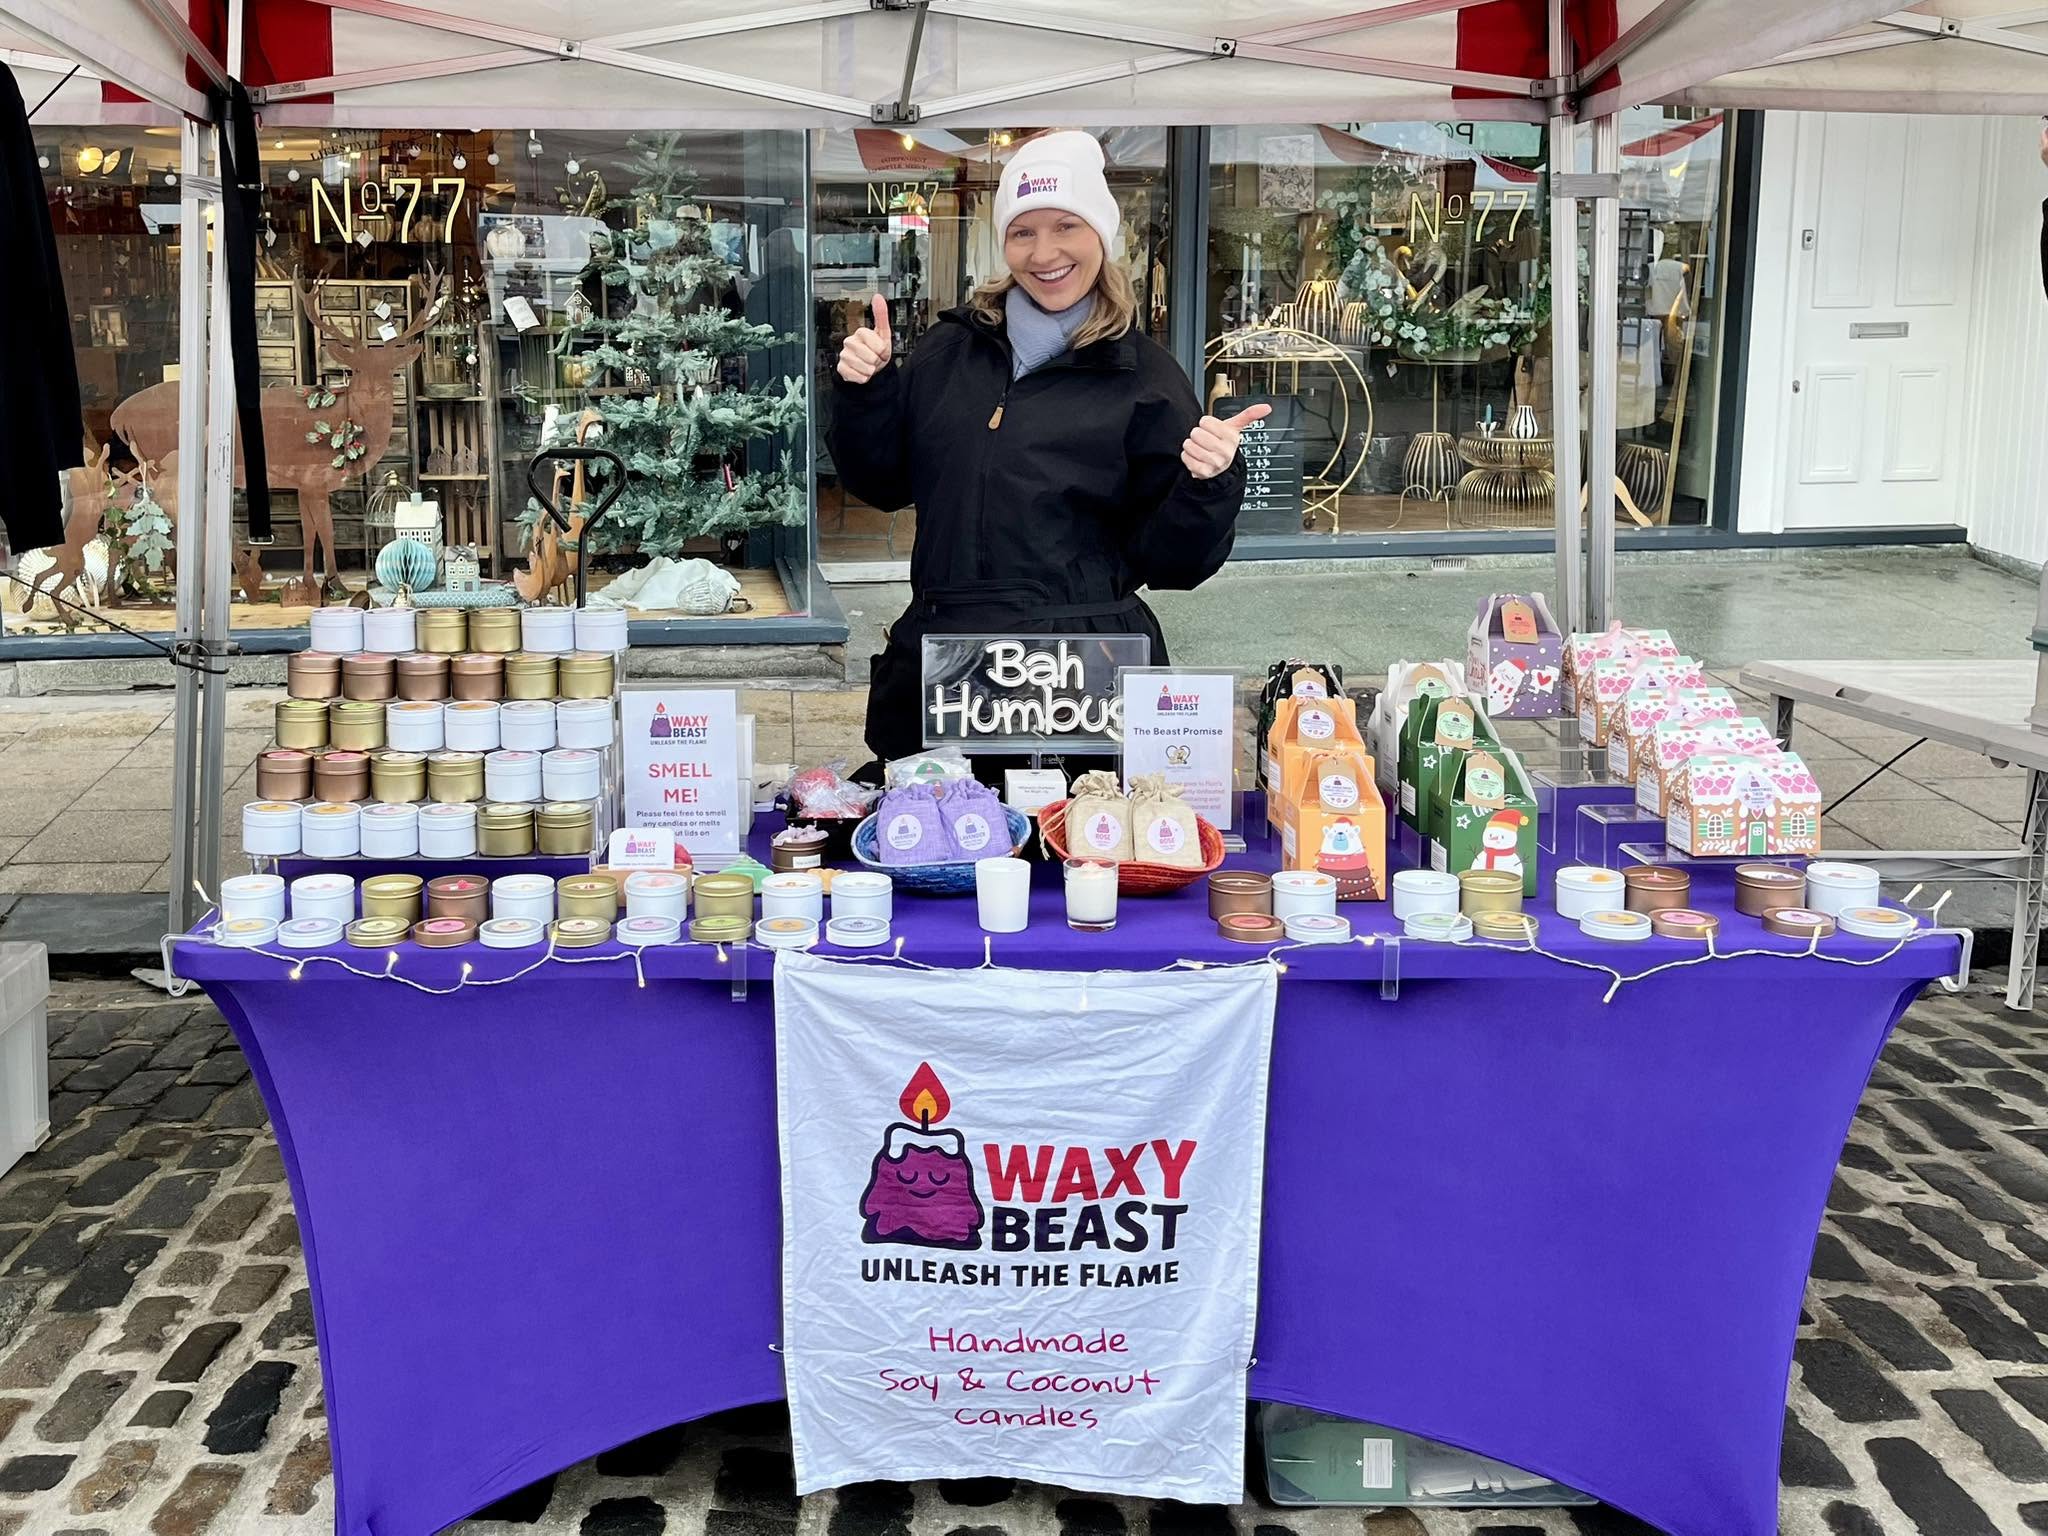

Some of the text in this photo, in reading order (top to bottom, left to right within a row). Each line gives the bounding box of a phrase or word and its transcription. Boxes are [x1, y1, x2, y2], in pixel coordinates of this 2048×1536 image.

[1031, 178, 1058, 186] WAXY
[1032, 185, 1058, 193] BEAST
[984, 639, 1085, 689] Bah
[1172, 694, 1199, 703] WAXY
[1173, 703, 1198, 711] BEAST
[671, 715, 708, 727] WAXY
[673, 727, 708, 738] BEAST
[648, 763, 713, 778] SMELL
[664, 788, 698, 803] ME!
[1095, 833, 1111, 841] ROSE
[982, 1137, 1198, 1203] WAXY
[990, 1200, 1190, 1252] BEAST
[860, 1256, 1180, 1288] UNLEASH THE FLAME
[928, 1326, 1129, 1355] Handmade
[879, 1367, 1162, 1402] Soy & Coconut
[954, 1404, 1099, 1430] candles
